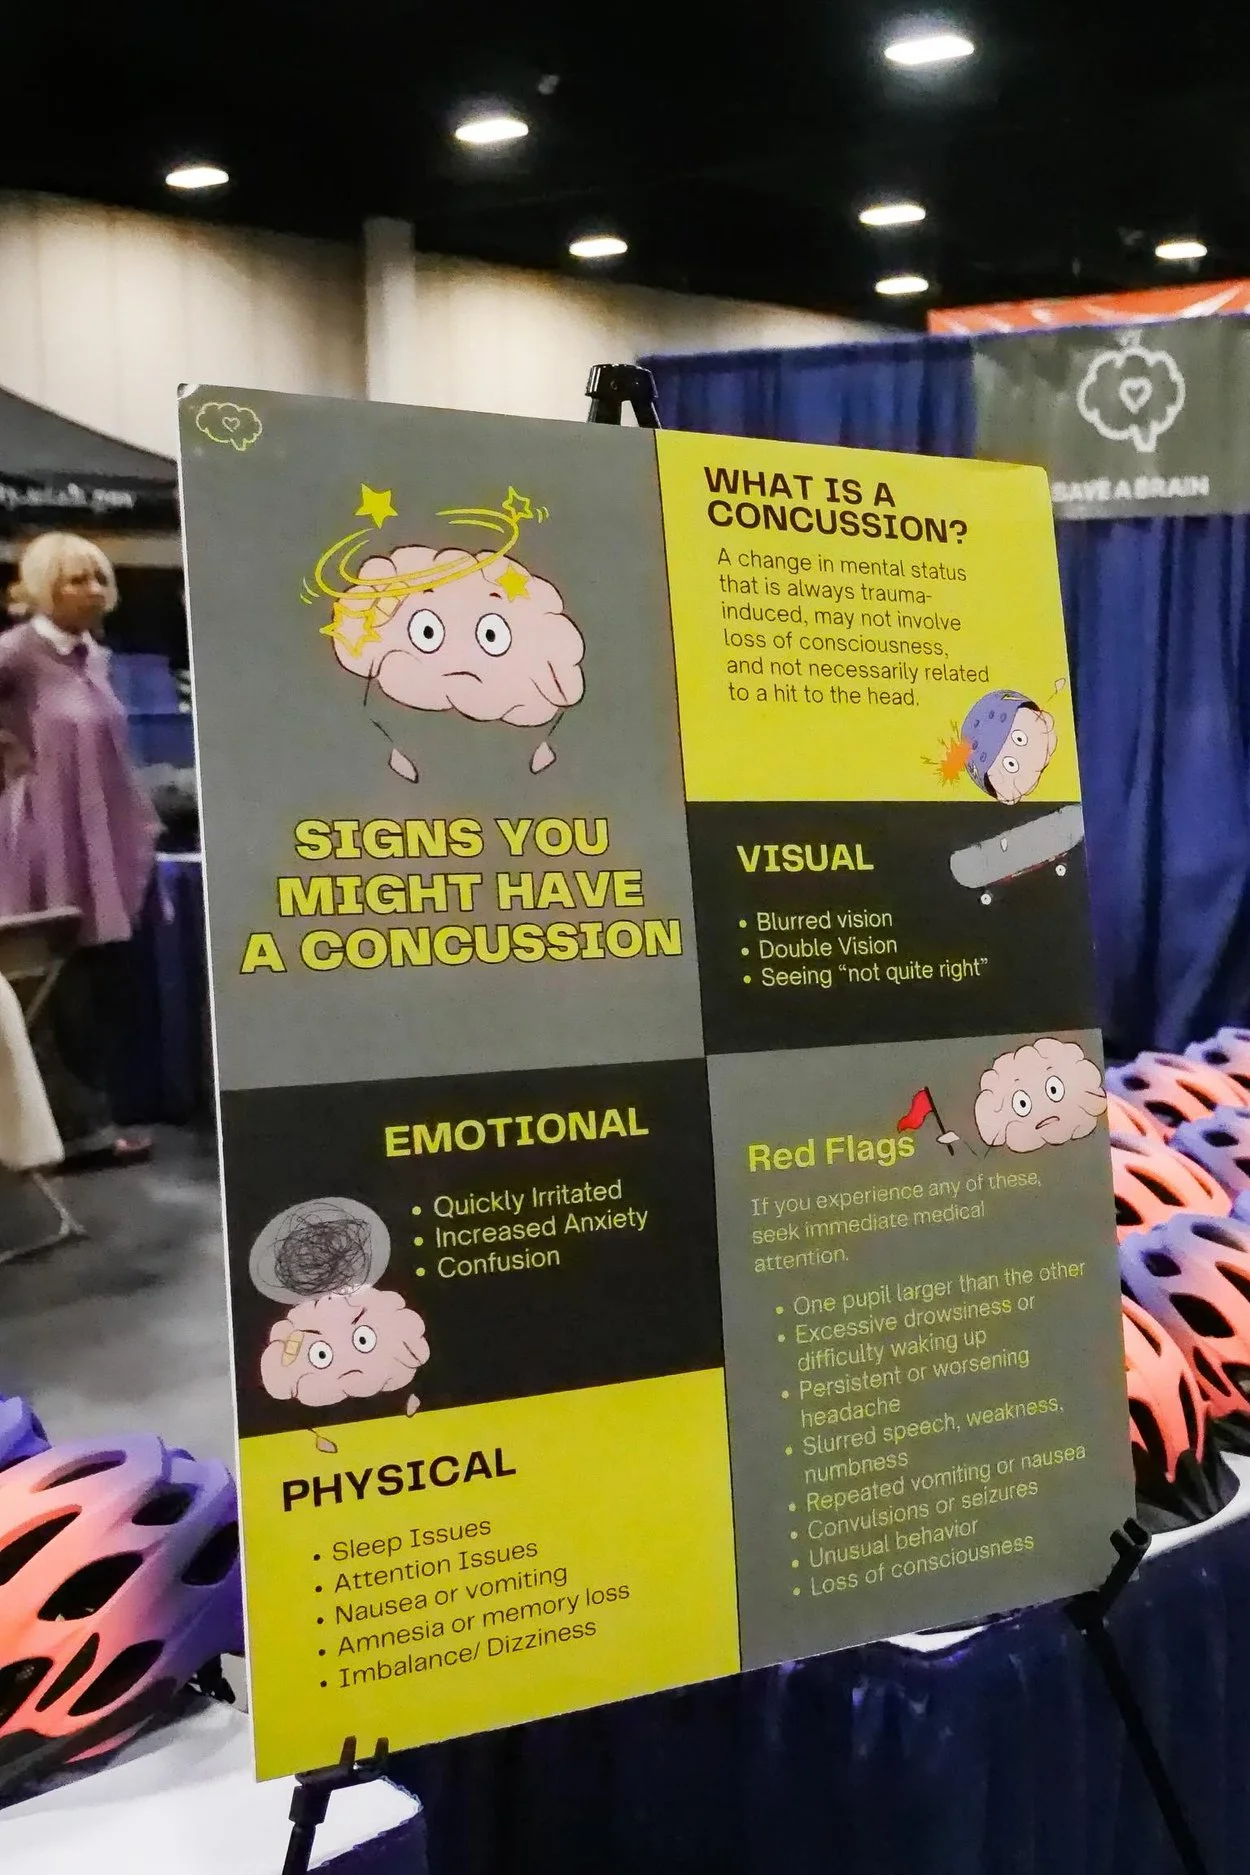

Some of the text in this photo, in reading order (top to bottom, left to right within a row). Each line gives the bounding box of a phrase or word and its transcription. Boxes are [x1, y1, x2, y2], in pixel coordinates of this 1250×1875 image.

[704, 466, 896, 508] WHAT IS A
[708, 500, 968, 544] CONCUSSION?
[718, 548, 967, 581] A change in mental status
[720, 576, 932, 604] that is always trauma-
[721, 601, 961, 631] induced, may not involve
[723, 629, 949, 659] loss of consciousness,
[727, 657, 989, 684] and not necessarily related
[729, 682, 919, 706] to a hit to the head.
[294, 817, 608, 860] SIGNS YOU
[737, 844, 874, 872] VISUAL
[277, 870, 644, 917] MIGHT HAVE
[757, 909, 892, 931] Blurred vision
[239, 919, 683, 974] A CONCUSSION
[759, 936, 898, 959] Double Vision
[762, 967, 832, 988] Seeing
[886, 960, 933, 984] quite
[384, 1107, 650, 1157] EMOTIONAL
[748, 1134, 915, 1172] Red Flags
[434, 1179, 622, 1219] Quickly Irritated
[752, 1198, 769, 1217] If
[775, 1196, 810, 1217] you
[816, 1183, 923, 1208] experience
[928, 1179, 960, 1199] any
[966, 1174, 984, 1192] of
[435, 1207, 648, 1248] Increased Anxiety
[752, 1201, 985, 1245] seek immediate medical
[437, 1248, 560, 1278] Confusion
[754, 1248, 849, 1273] attention.
[794, 1261, 1085, 1316] One pupil larger than the other
[796, 1294, 1035, 1344] Excessive drowsiness or
[797, 1327, 987, 1371] difficulty waking up
[799, 1350, 1030, 1400] Persistent or worsening
[800, 1397, 901, 1428] headache
[803, 1396, 1064, 1456] Slurred speech, weakness,
[283, 1447, 516, 1512] PHYSICAL
[805, 1451, 908, 1484] numbness
[806, 1444, 1086, 1513] Repeated vomiting or nausea
[808, 1479, 1038, 1540] Convulsions or seizures
[332, 1519, 492, 1562] Sleep Issues
[809, 1518, 979, 1569] Unusual behavior
[335, 1541, 538, 1593] Attention Issues
[810, 1532, 1035, 1597] Loss of consciousness
[335, 1565, 568, 1625] Nausea or vomiting
[338, 1582, 631, 1657] Amnesia or memory loss
[339, 1620, 597, 1688] Imbalance/ Dizziness
